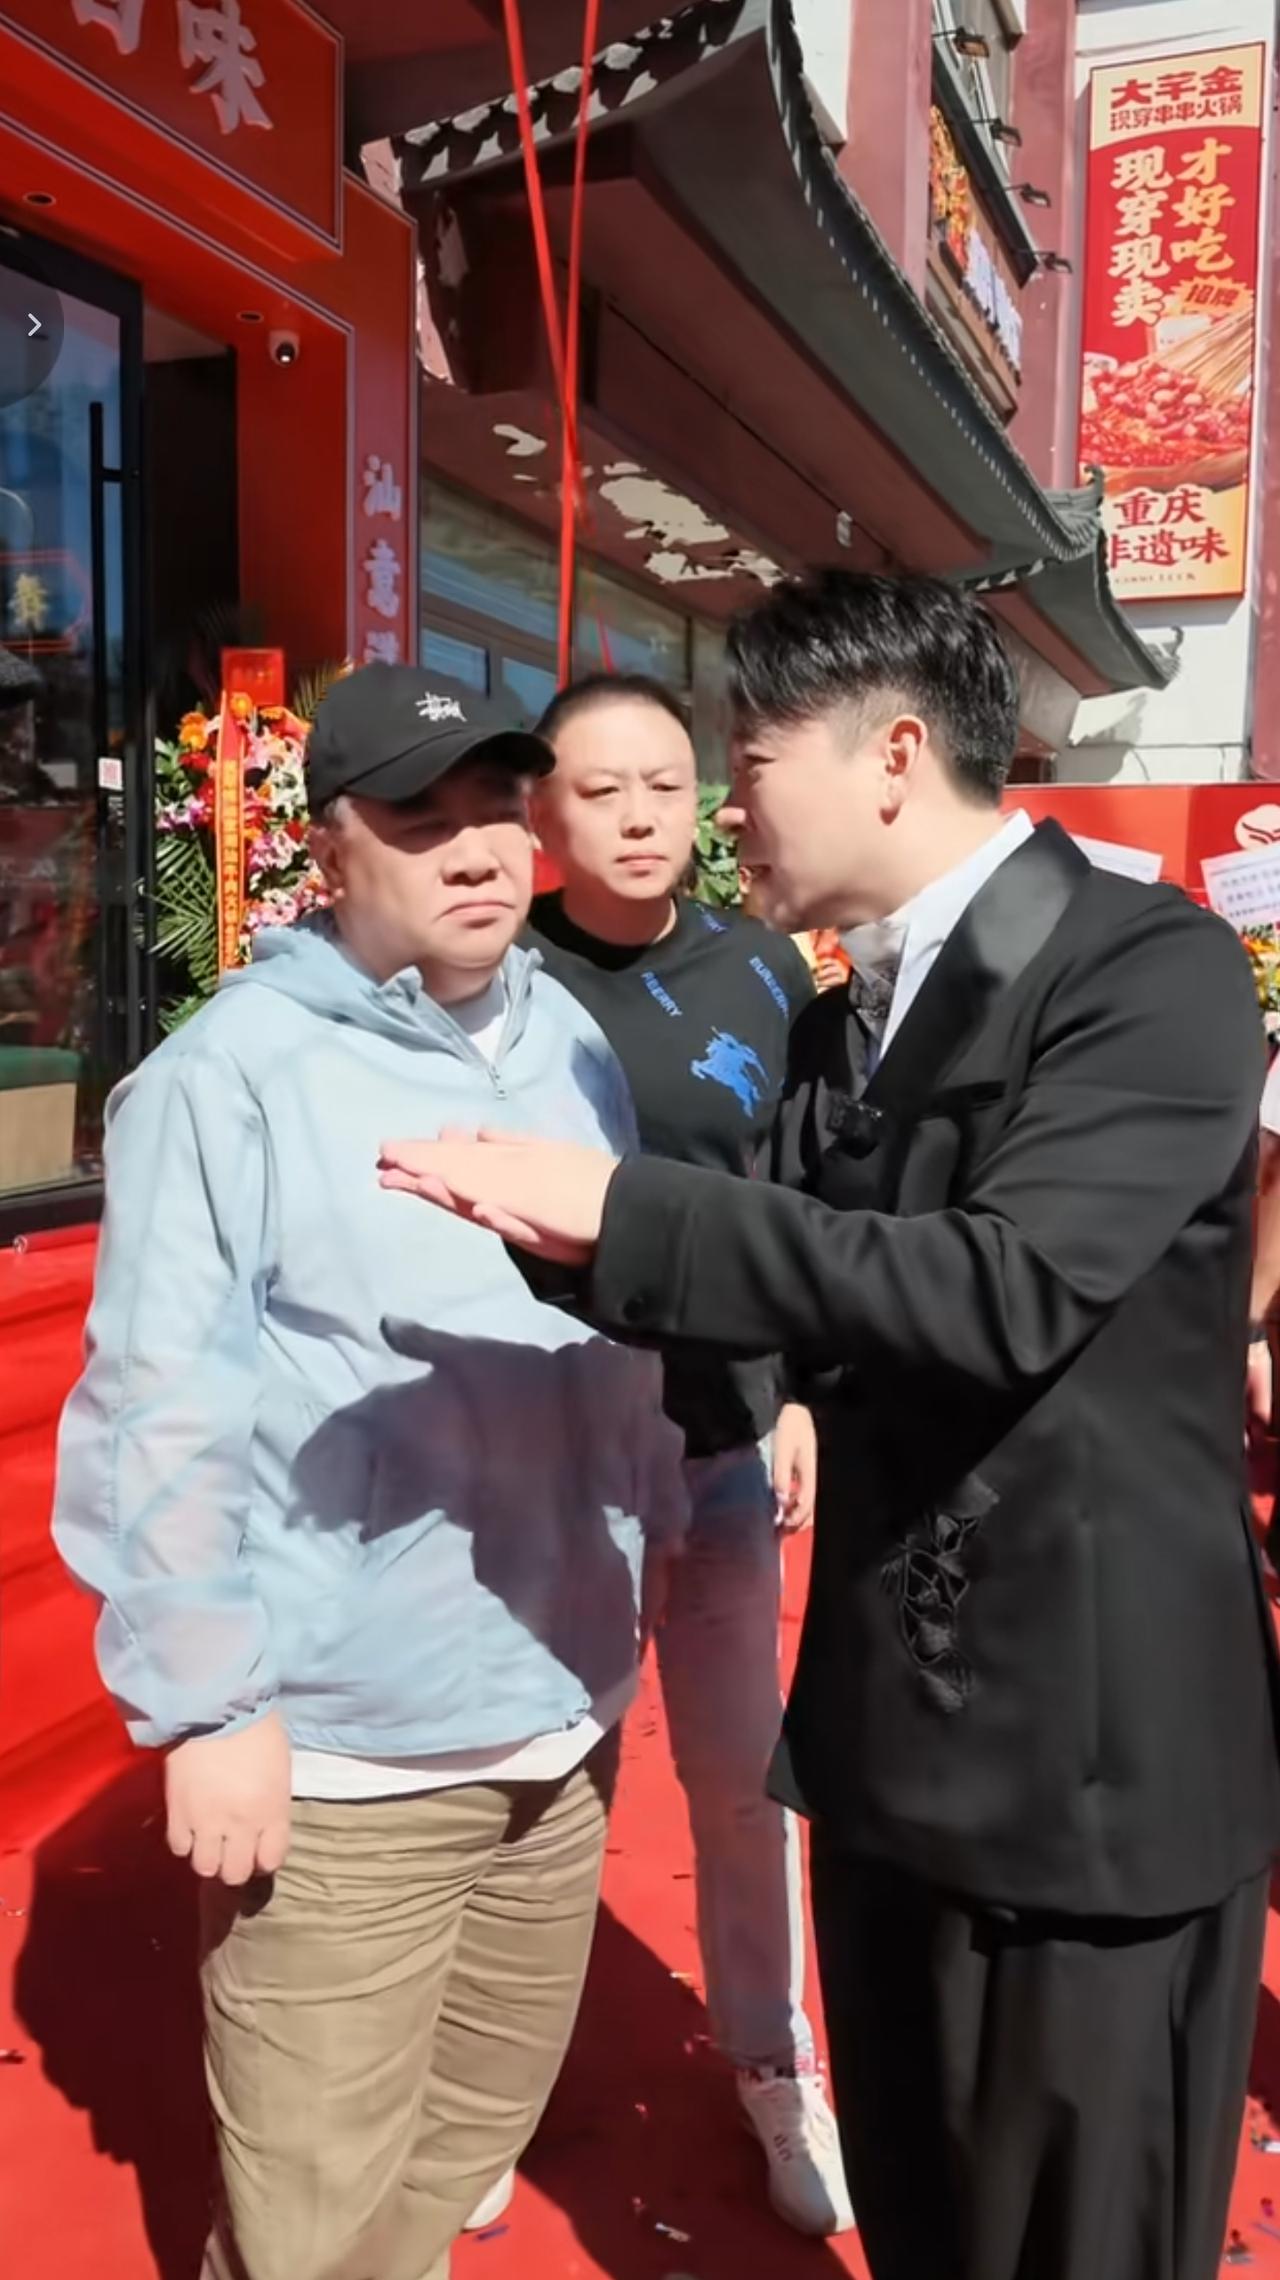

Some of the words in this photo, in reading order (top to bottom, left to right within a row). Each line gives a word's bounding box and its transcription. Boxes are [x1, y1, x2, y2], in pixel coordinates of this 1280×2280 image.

[1109, 94, 1243, 132] 现穿串串火锅
[1108, 146, 1174, 327] 现穿现卖
[1169, 136, 1237, 273] 才好吃
[1112, 488, 1206, 530] 重庆
